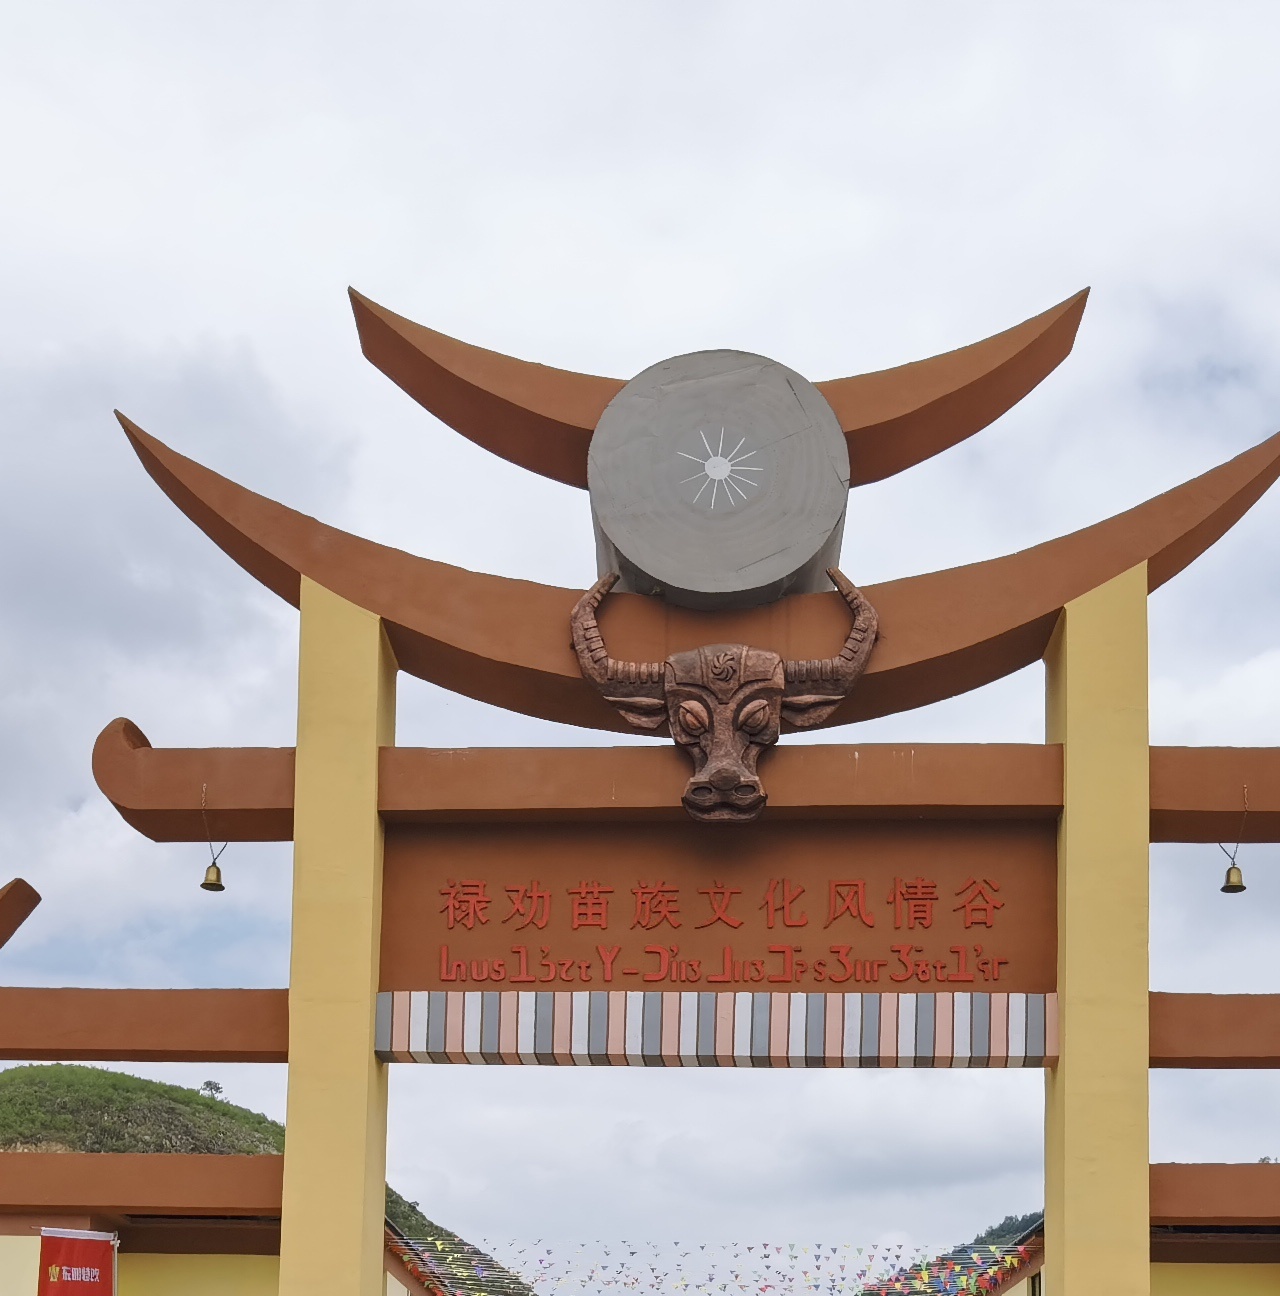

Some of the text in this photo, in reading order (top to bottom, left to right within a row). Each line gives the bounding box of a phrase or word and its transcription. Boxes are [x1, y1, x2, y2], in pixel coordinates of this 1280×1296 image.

[438, 876, 1005, 931] 禄劝苗族文化风情谷
